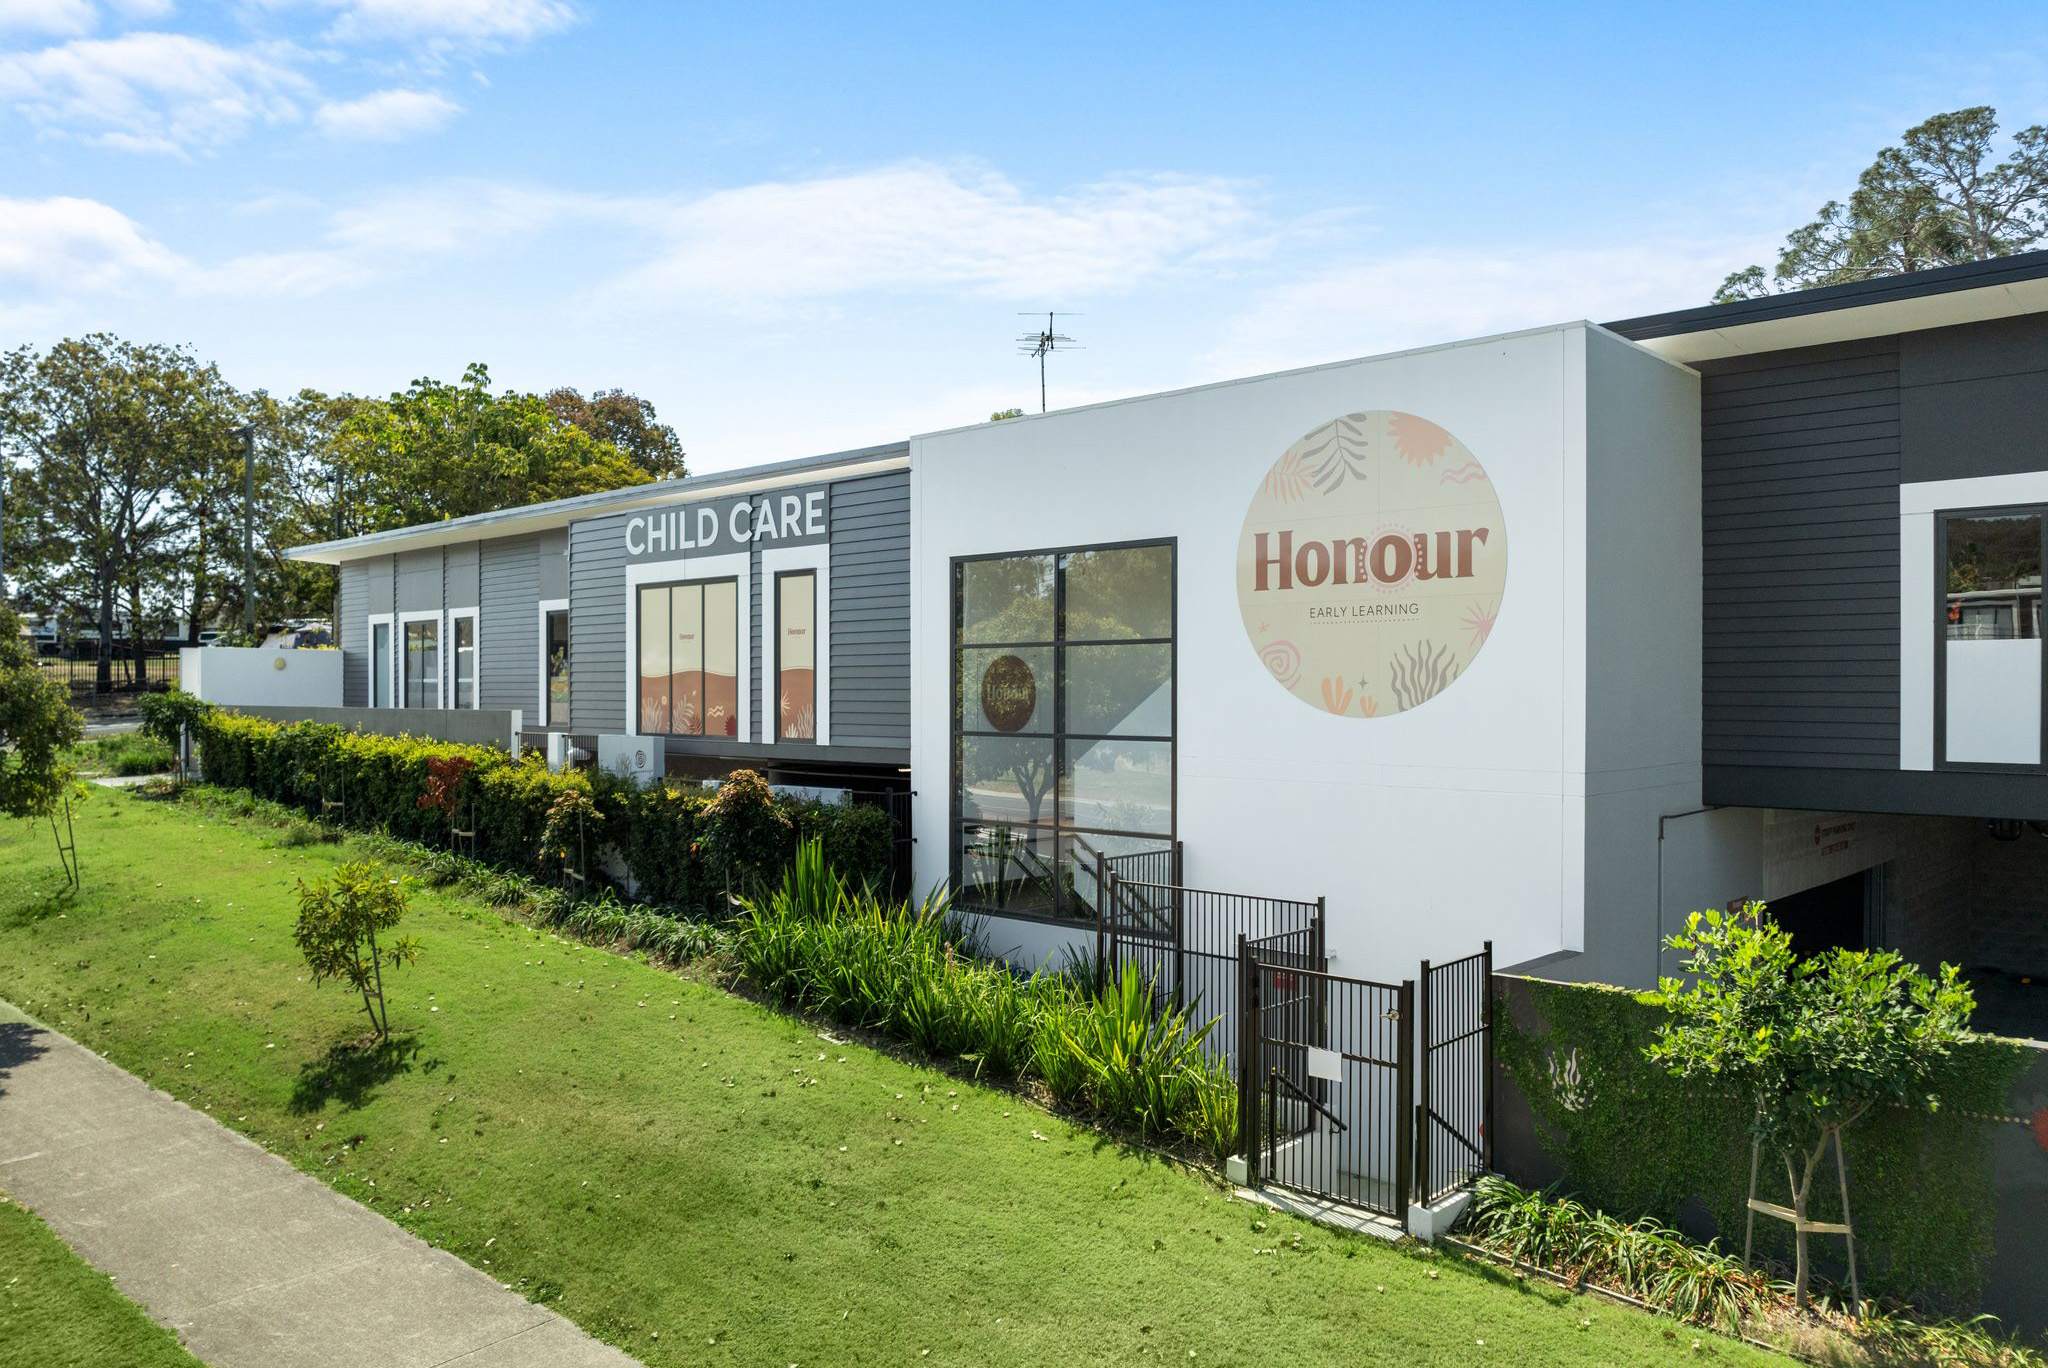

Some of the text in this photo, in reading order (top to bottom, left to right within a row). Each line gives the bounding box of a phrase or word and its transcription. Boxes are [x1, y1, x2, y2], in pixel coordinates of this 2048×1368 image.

[626, 491, 826, 555] CHILD CARE
[1254, 527, 1490, 591] Honour
[1309, 603, 1419, 619] EARLY LEARNING
